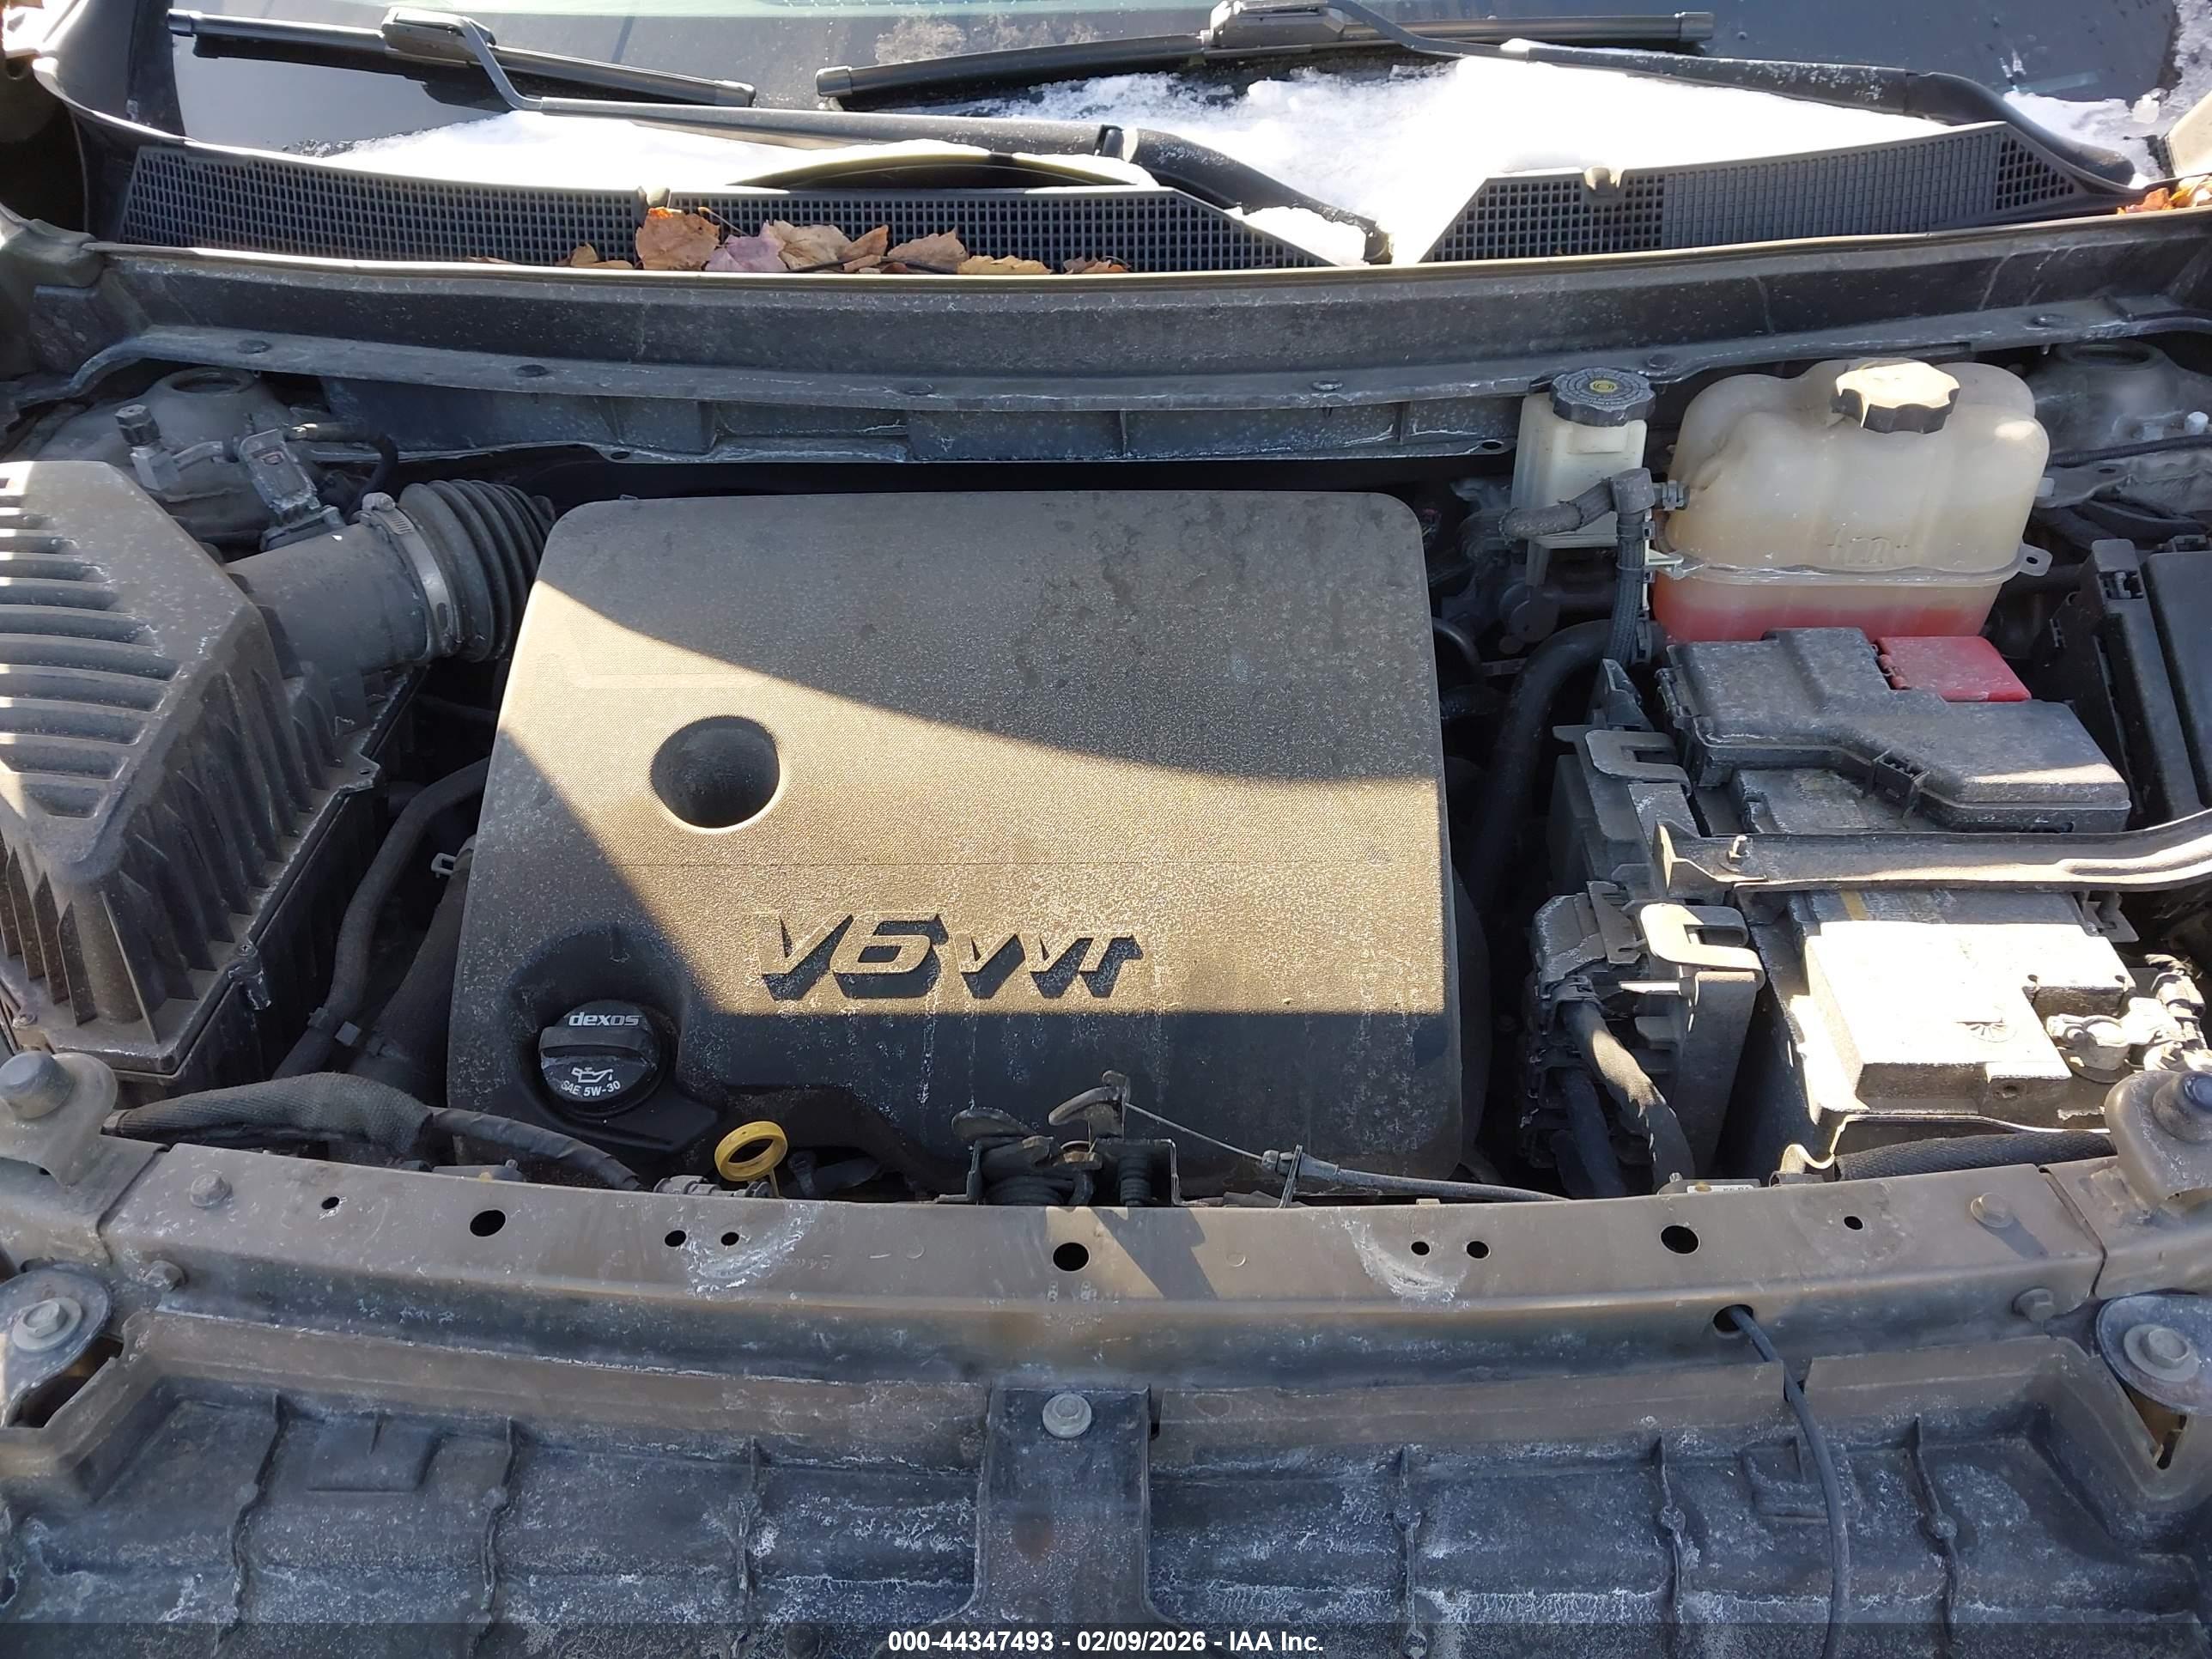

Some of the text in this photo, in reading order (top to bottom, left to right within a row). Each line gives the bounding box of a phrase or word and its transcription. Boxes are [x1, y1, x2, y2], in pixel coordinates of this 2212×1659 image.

[568, 1012, 641, 1026] dexos
[561, 1080, 621, 1097] SAE 5W-30
